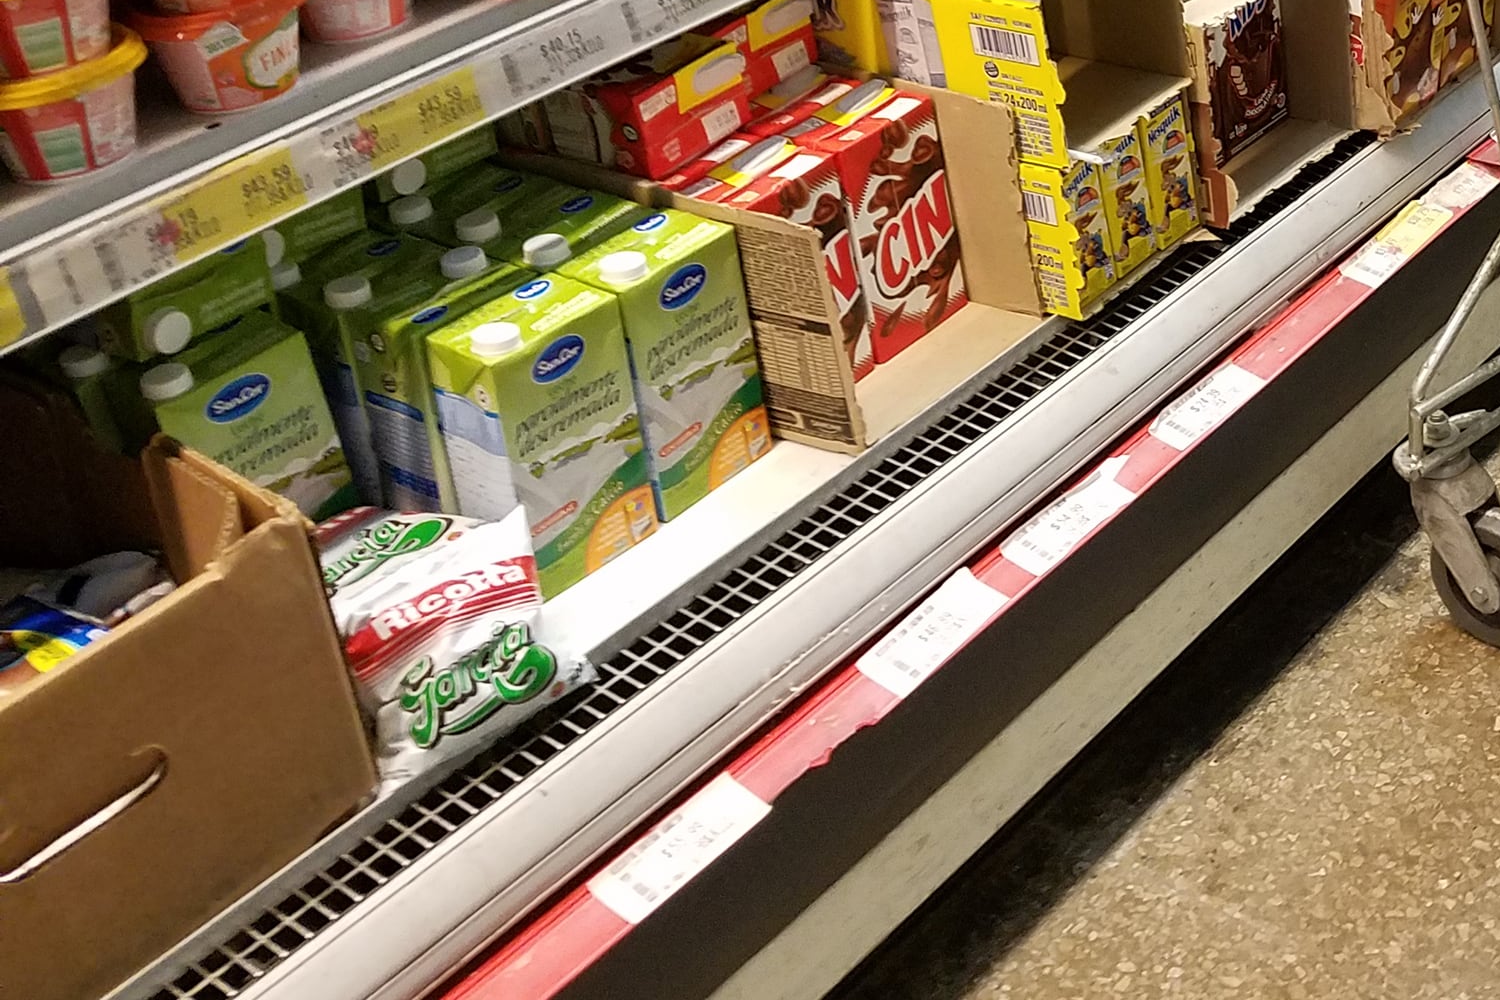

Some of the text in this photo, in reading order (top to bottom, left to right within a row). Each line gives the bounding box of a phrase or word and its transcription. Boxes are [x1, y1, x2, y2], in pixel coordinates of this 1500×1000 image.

[1148, 106, 1182, 147] Nesquik
[210, 383, 266, 414] SanCor
[370, 561, 529, 642] Ricotta
